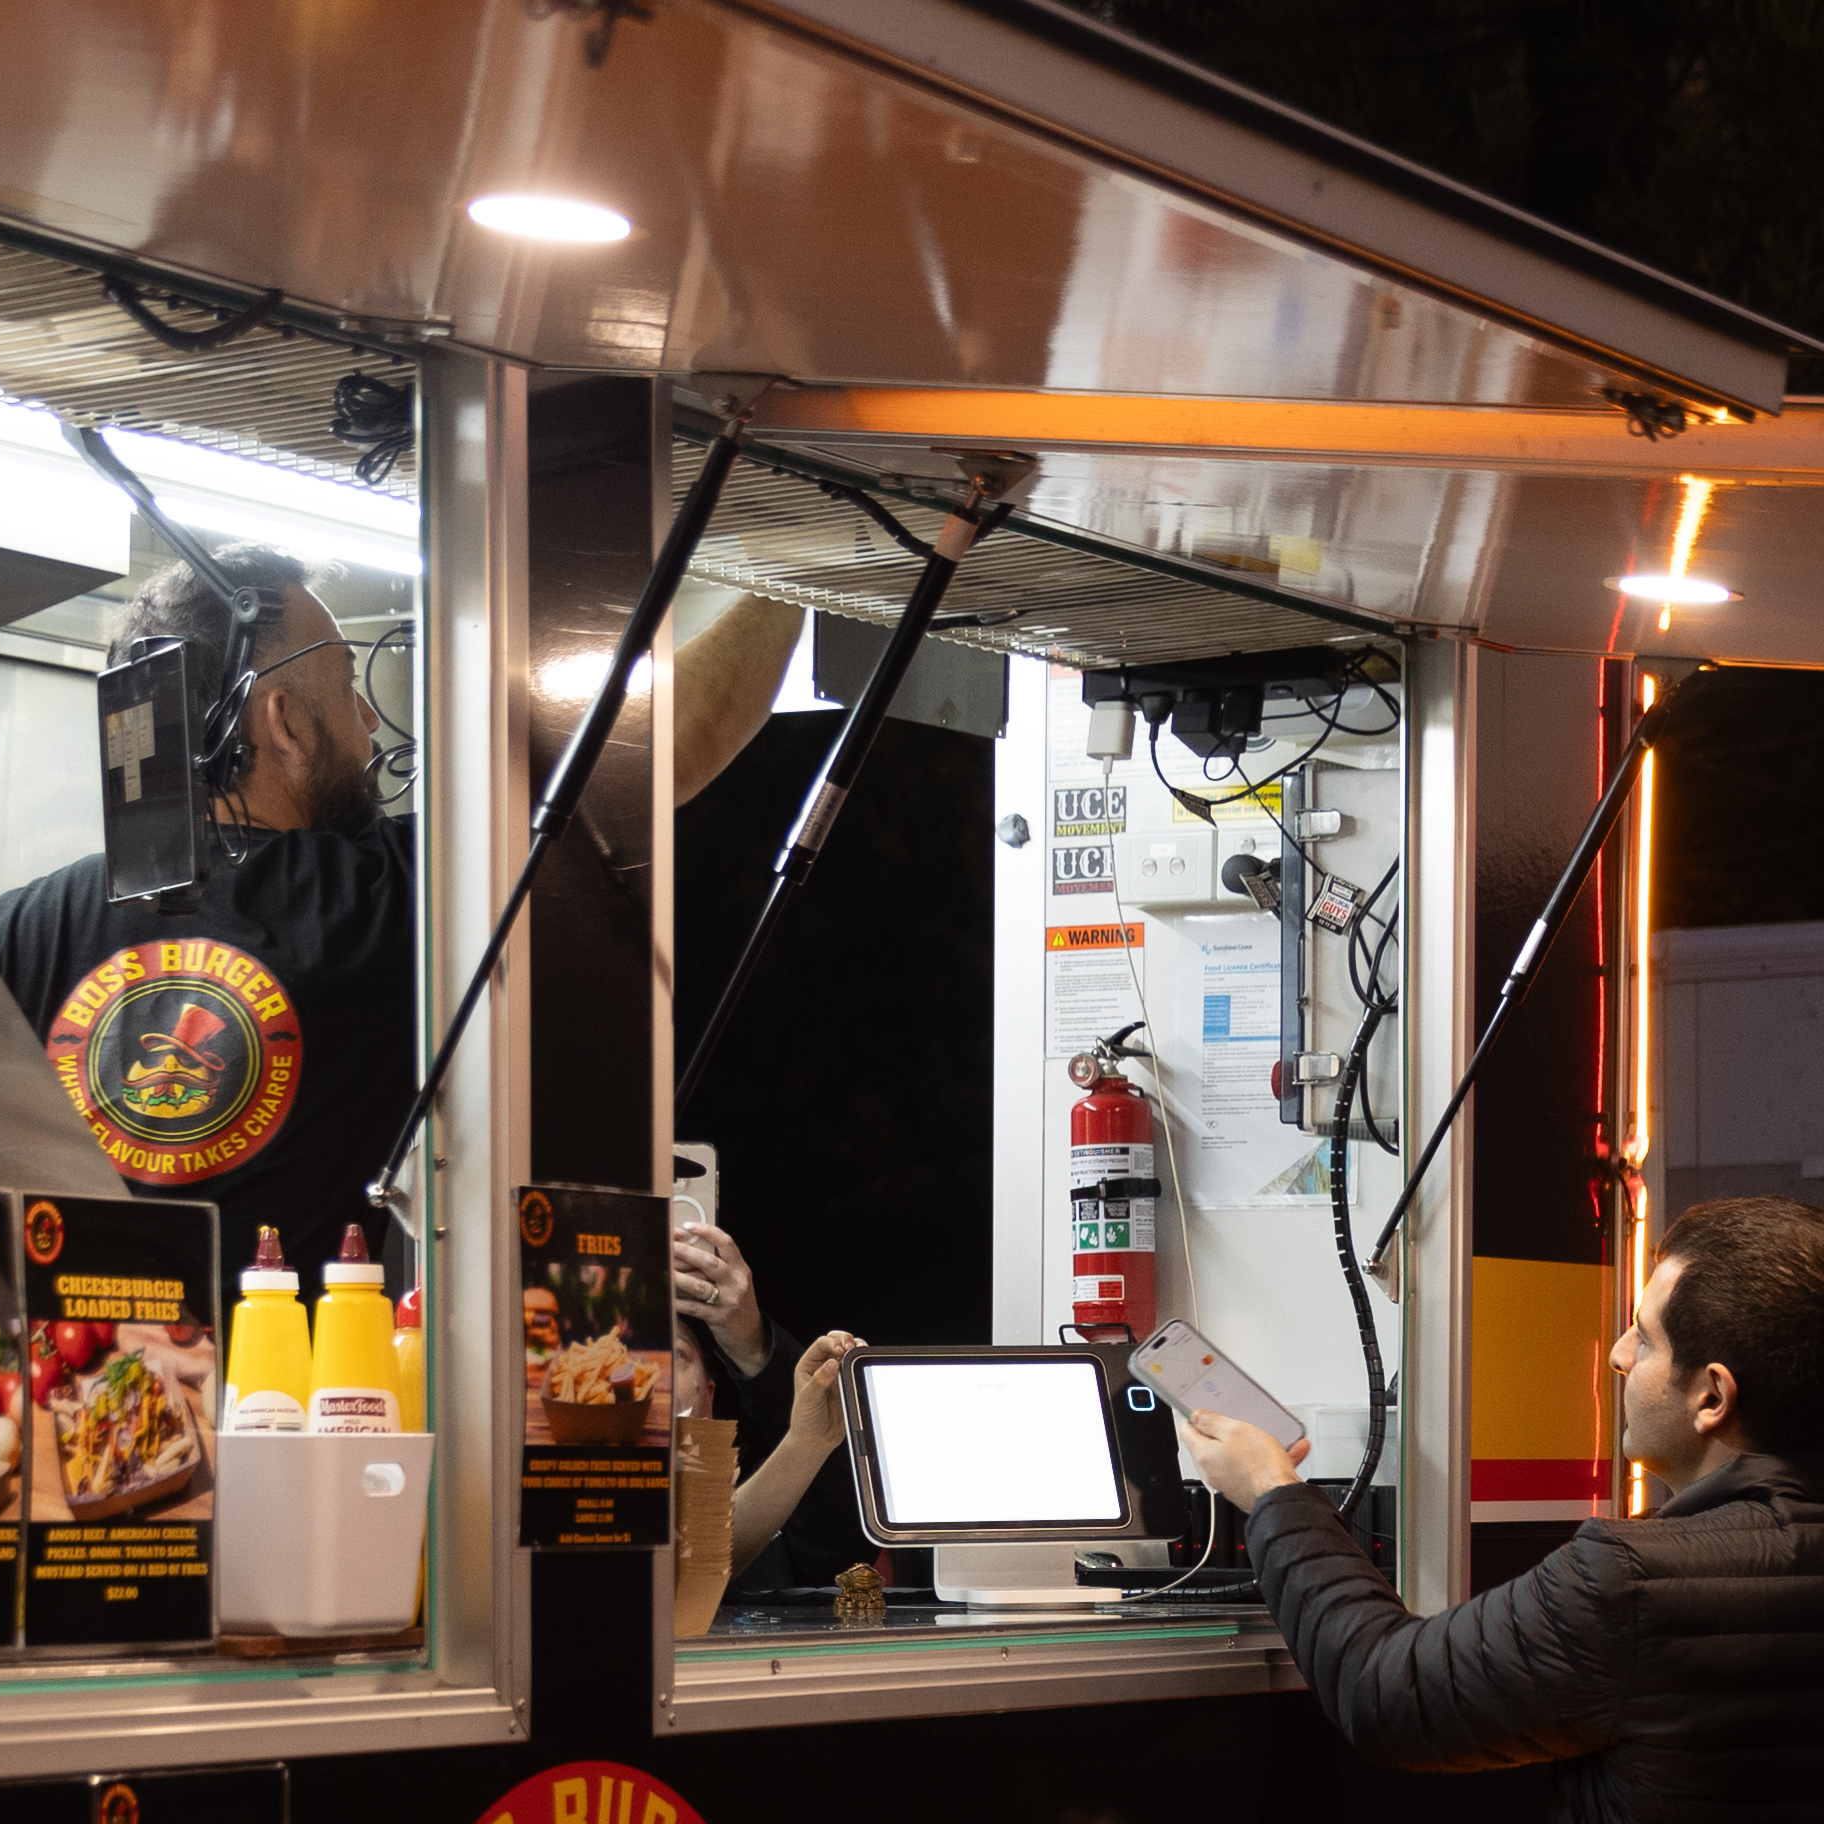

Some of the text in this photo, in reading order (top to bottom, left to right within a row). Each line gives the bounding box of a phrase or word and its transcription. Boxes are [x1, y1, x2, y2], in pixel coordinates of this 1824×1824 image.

[1056, 788, 1125, 821] UCE
[1056, 822, 1125, 837] MOVEMENT
[1055, 880, 1114, 894] MOVEMEN
[1322, 901, 1349, 920] GUYS
[1068, 928, 1136, 946] WARNING
[1204, 961, 1281, 971] Food Licence Certificat
[62, 943, 288, 1028] BOSS BURGER
[91, 1121, 176, 1174] FLAVOUR
[179, 1132, 248, 1173] TAKES
[243, 1055, 293, 1137] CHARGE
[576, 1233, 621, 1256] FRIES
[57, 1275, 185, 1301] CHEESEBURGER
[63, 1298, 181, 1322] LOADED FRIES
[319, 1397, 387, 1416] MasterFoods
[612, 1460, 641, 1472] SERVED
[642, 1460, 663, 1472] WITH
[48, 1527, 161, 1543] ANGUS AMERICAN
[125, 1545, 166, 1559] TOMATO
[35, 1562, 208, 1580] MUSTARD SERVED ON A BED OF FRIES
[105, 1585, 139, 1601] $22.00
